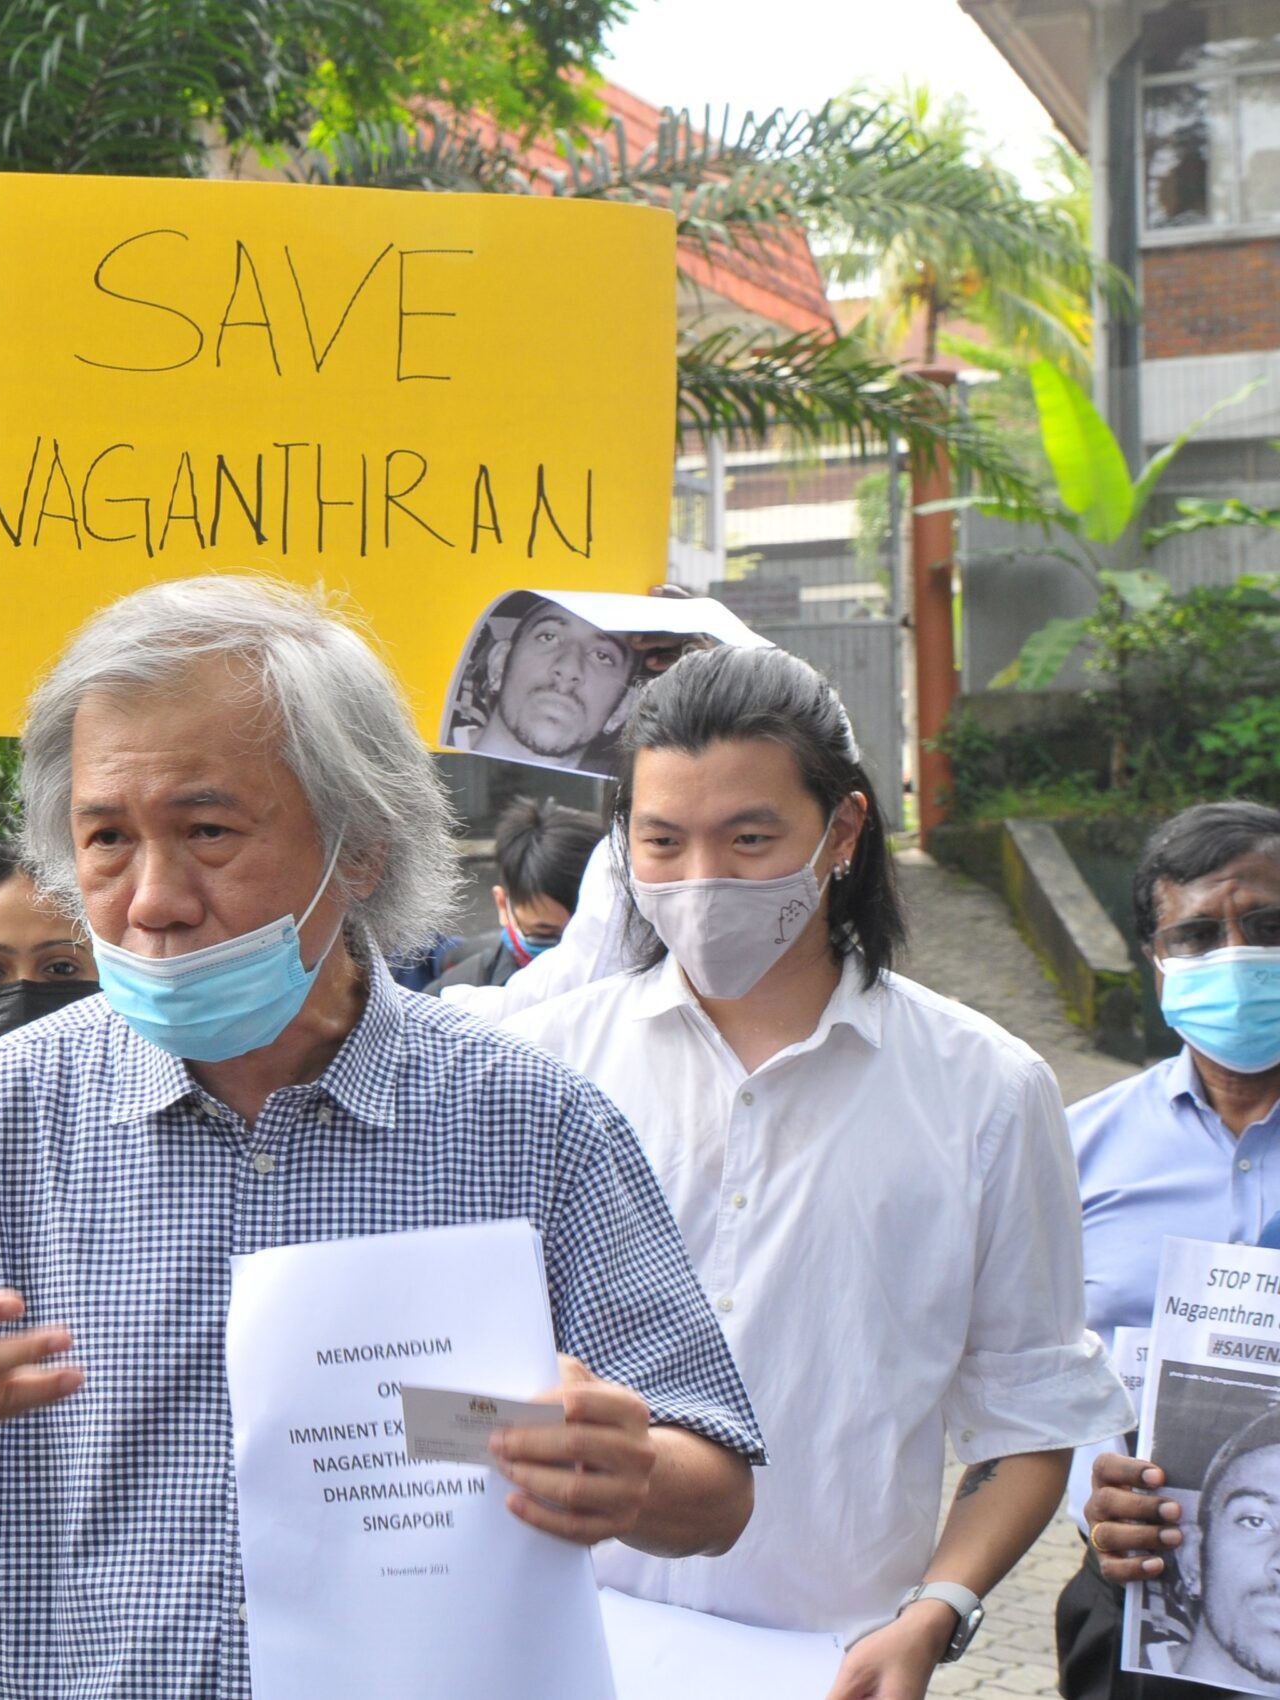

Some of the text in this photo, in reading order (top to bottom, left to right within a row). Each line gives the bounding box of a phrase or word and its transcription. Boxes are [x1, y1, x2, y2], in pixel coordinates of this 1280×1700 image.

[73, 228, 474, 382] SAVE
[1207, 1268, 1280, 1295] STOP TH
[1165, 1296, 1274, 1328] Nagaenthran
[317, 1337, 452, 1366] MEMORANDUM
[1212, 1339, 1280, 1364] #SAVEN
[378, 1381, 402, 1398] ON
[289, 1421, 378, 1444] IMMINENT
[324, 1477, 485, 1503] DHARMALINGAM IN
[363, 1510, 455, 1532] SINGAPORE
